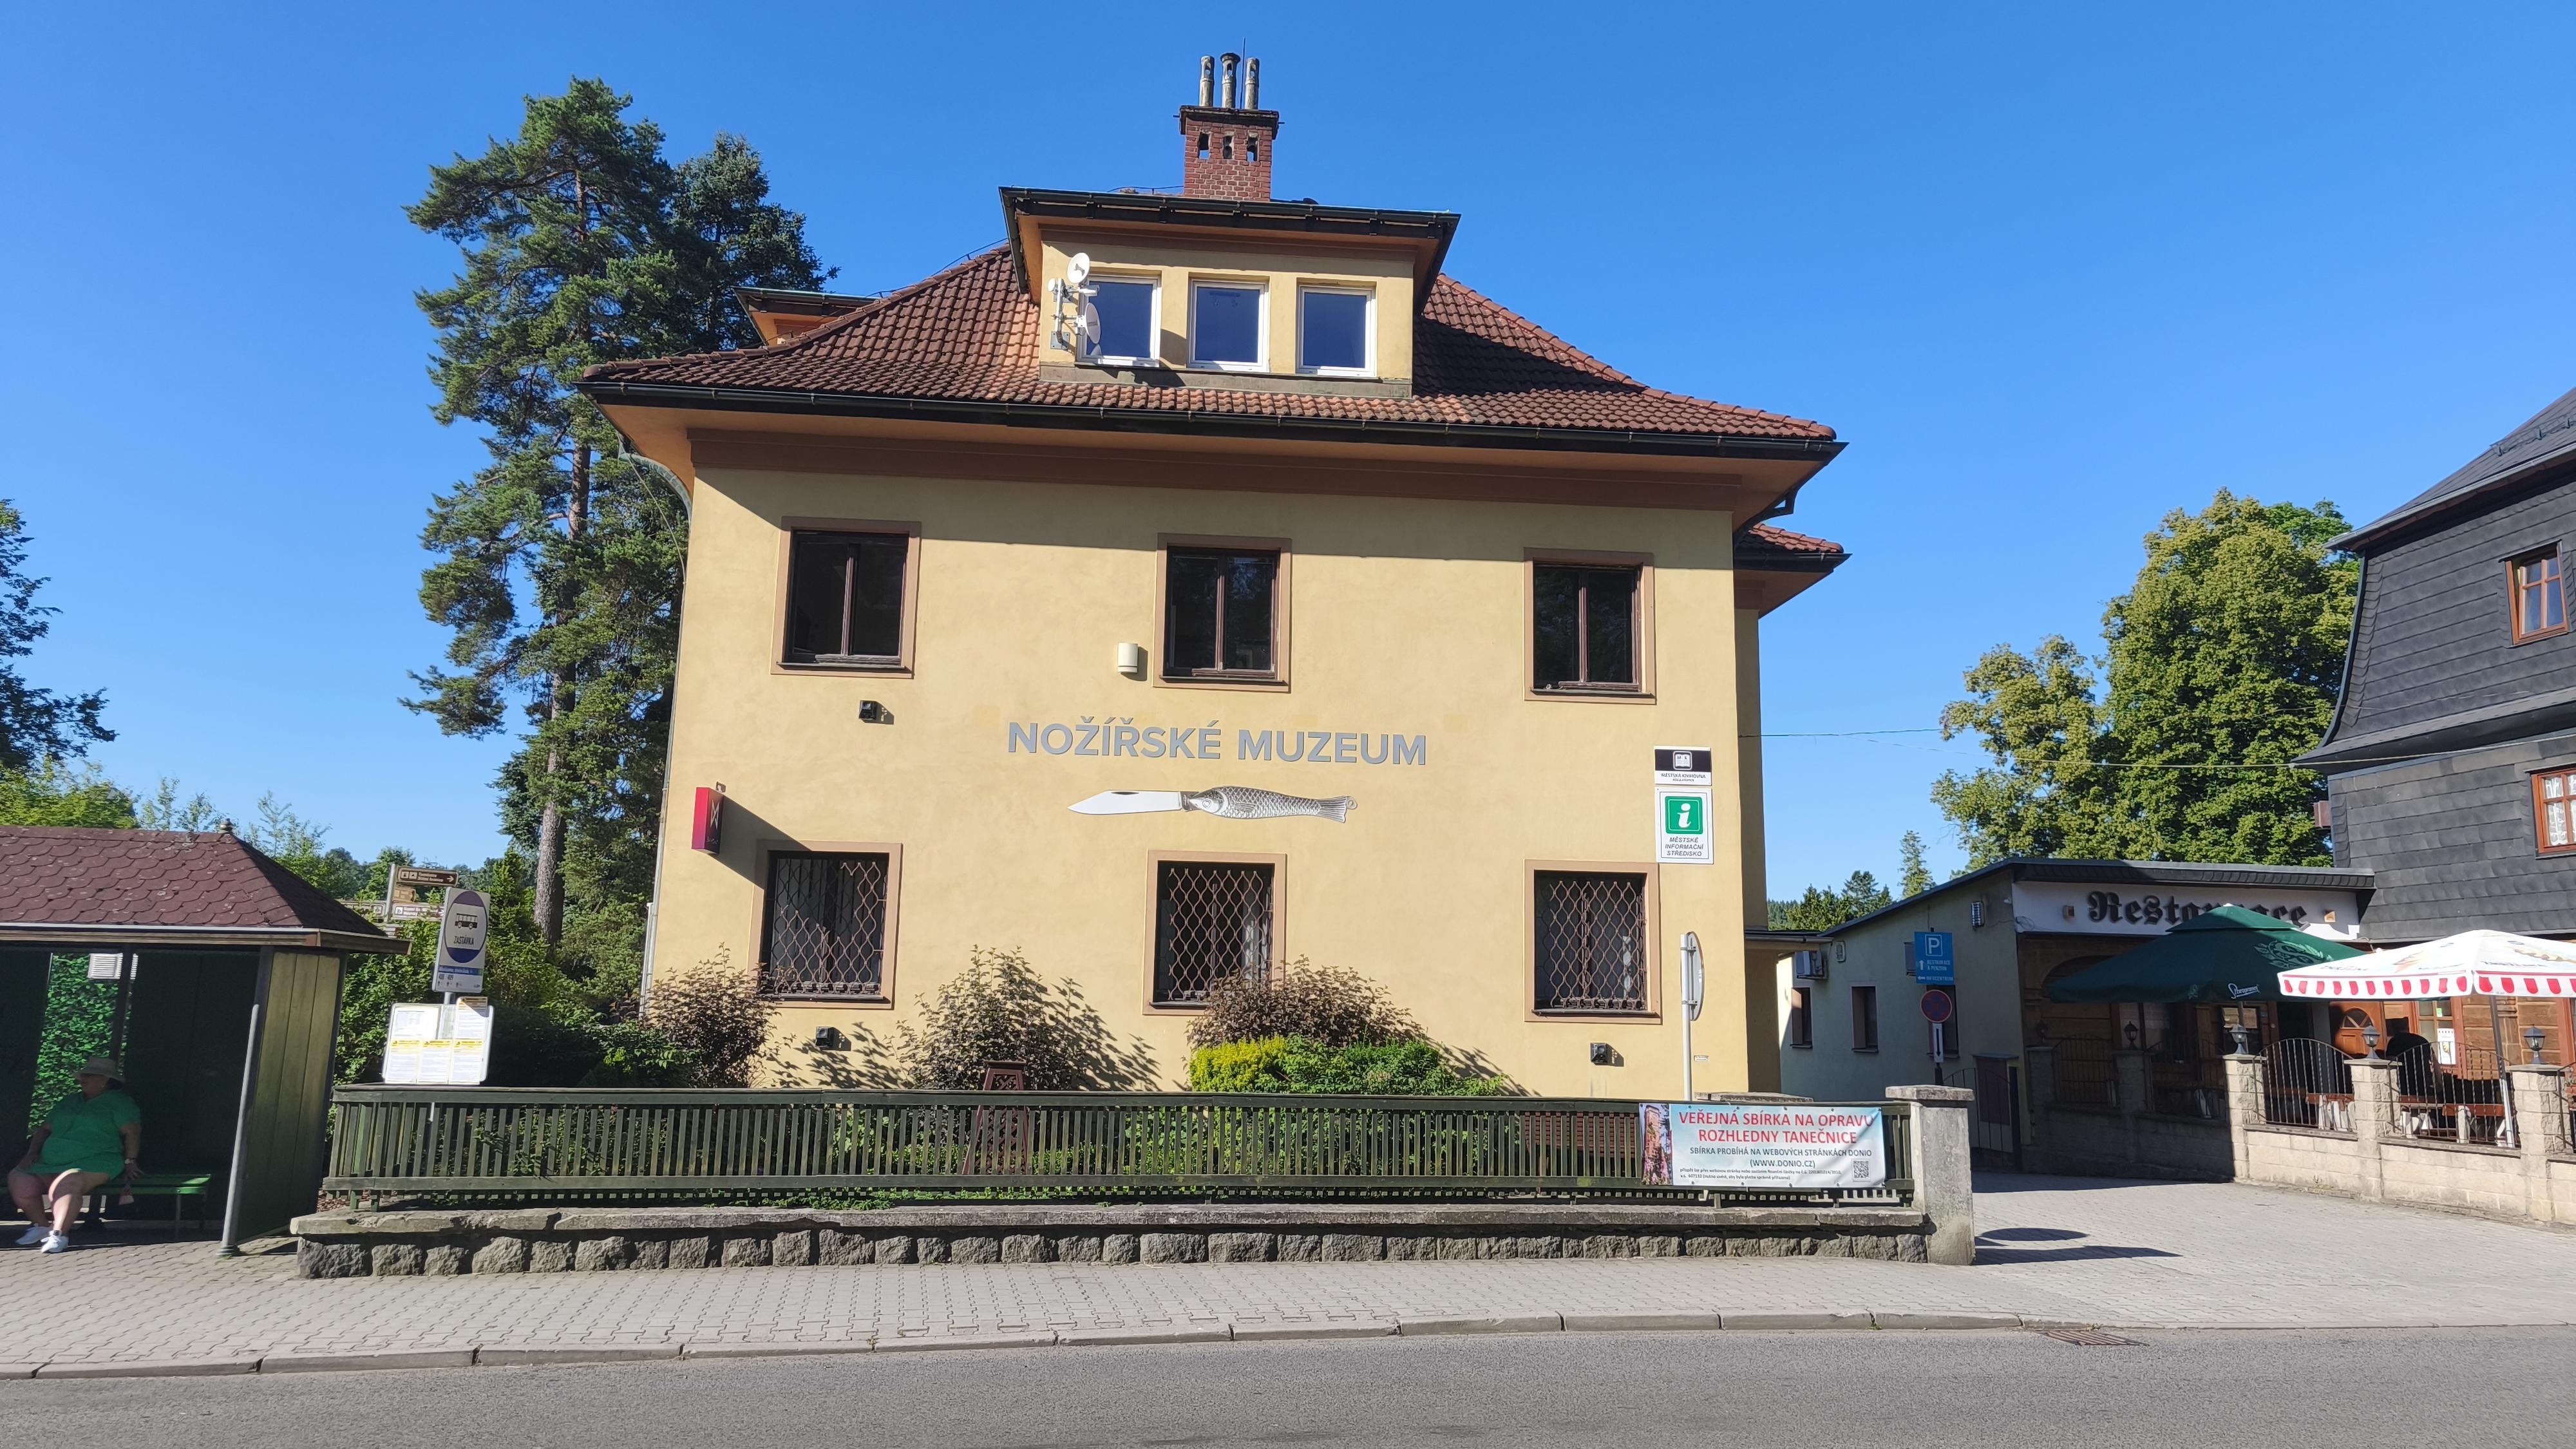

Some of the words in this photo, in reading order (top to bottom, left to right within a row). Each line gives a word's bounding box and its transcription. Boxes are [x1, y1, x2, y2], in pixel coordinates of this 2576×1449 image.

[1007, 715, 1222, 759] NOŽÍŘSKÉ
[1237, 729, 1426, 766] MUZEUM
[454, 934, 474, 945] ZASTÁVKA
[1928, 937, 1940, 954] P
[1679, 1108, 1739, 1124] VEŘEJNÁ
[1743, 1110, 1790, 1126] SBÍRKA
[1795, 1113, 1814, 1126] NA
[1818, 1114, 1874, 1127] OPRAVU
[1699, 1129, 1779, 1142] ROZHLEDNY
[1783, 1128, 1857, 1143] TANEČNICE
[1690, 1146, 1716, 1154] SBÍRKA
[1717, 1146, 1748, 1155] PROBÍHÁ
[1763, 1147, 1803, 1156] WEBOVÝCH
[1804, 1147, 1847, 1157] STRÁNKÁCH
[1750, 1159, 1815, 1169] (WWW.DONIO.CZ)
